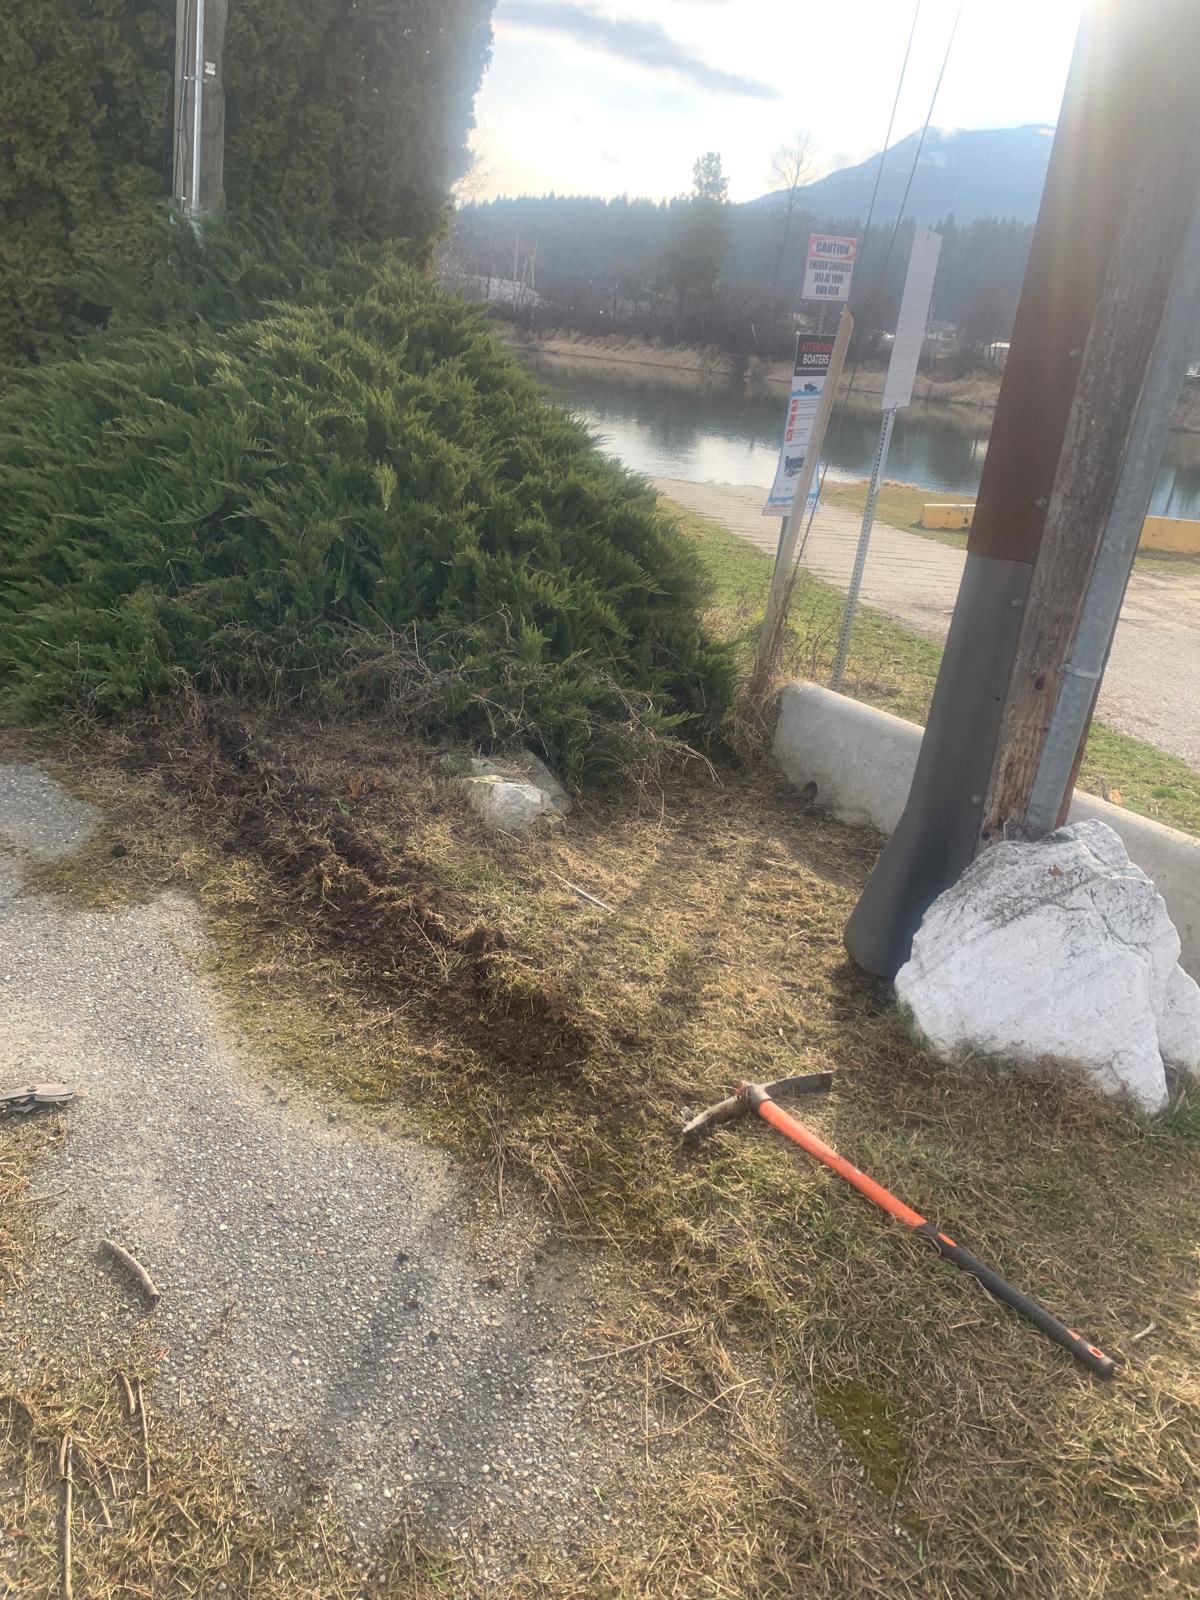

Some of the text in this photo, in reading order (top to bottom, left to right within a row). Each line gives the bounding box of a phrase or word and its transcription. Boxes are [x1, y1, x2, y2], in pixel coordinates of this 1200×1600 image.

[816, 241, 850, 255] CAUTION
[809, 259, 851, 272] UNEVEN SURFACES
[814, 273, 844, 284] USE AT YOUR
[815, 285, 840, 296] OWN RISK
[800, 342, 832, 353] ATTENTIO
[803, 354, 830, 365] BOATERS
